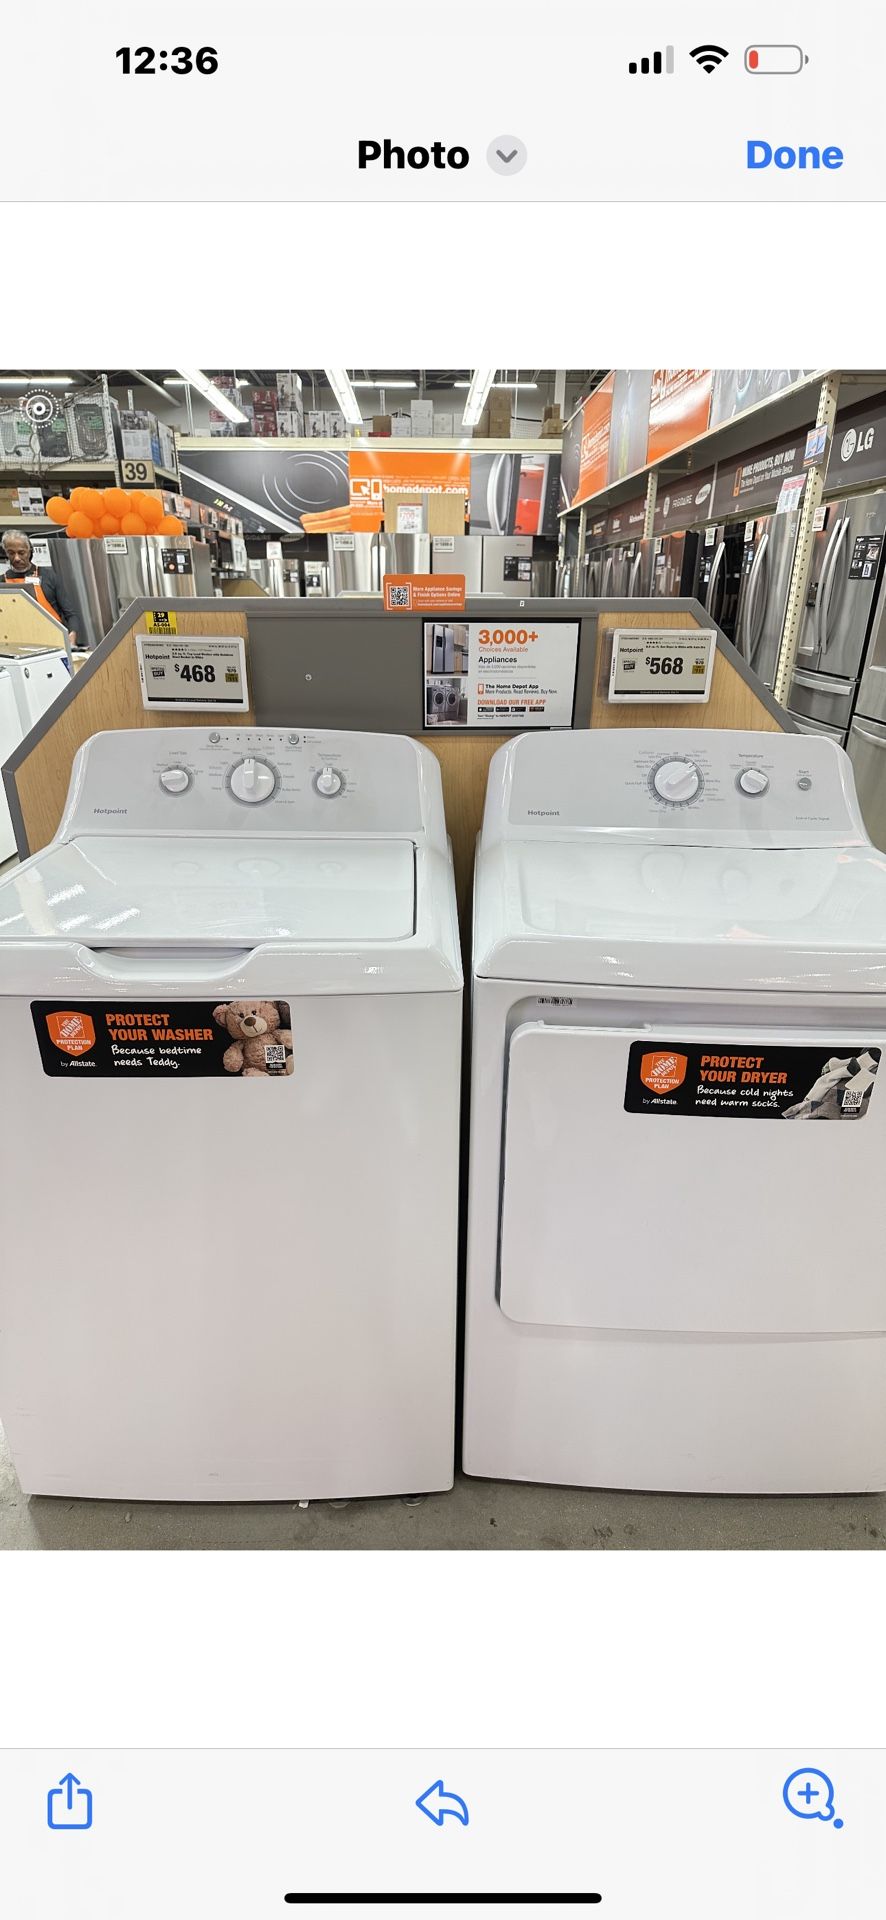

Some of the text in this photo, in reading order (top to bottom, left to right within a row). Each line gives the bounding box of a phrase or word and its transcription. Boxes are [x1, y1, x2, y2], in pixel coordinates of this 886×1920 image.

[856, 427, 875, 452] LG
[774, 452, 784, 466] BUY
[784, 448, 796, 463] NOW
[124, 462, 147, 481] 39
[383, 483, 468, 494] homedepot.com
[478, 629, 539, 646] 3,000+
[478, 656, 518, 664] Appliances
[645, 656, 684, 675] $568
[174, 663, 216, 683] $468
[105, 1013, 170, 1026] PROTECT
[108, 1028, 214, 1041] YOUR WASHER
[111, 1044, 202, 1055] Because bedtime
[113, 1056, 180, 1069] needs Teddy.
[700, 1055, 764, 1069] PROTECT
[699, 1070, 788, 1084] YOUR DRYER
[697, 1084, 794, 1102] Because cold nights
[695, 1098, 717, 1106] need
[751, 1100, 780, 1108] socks.
